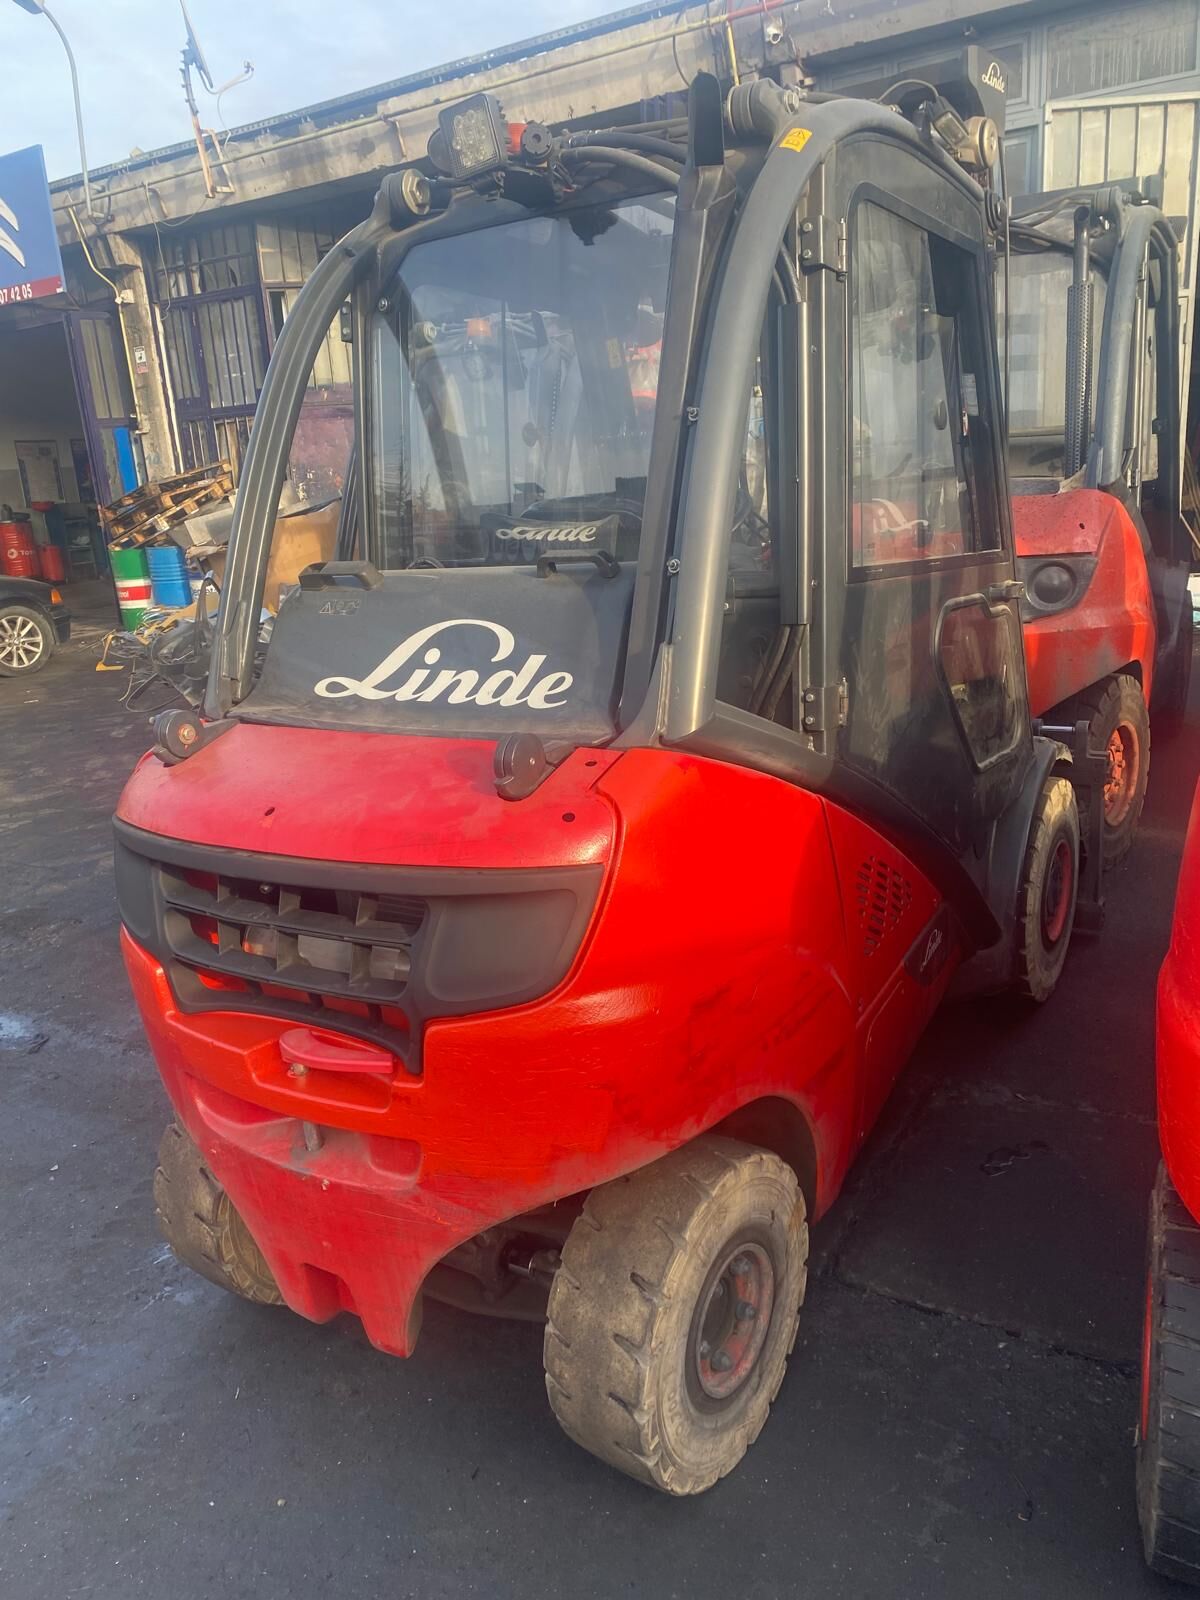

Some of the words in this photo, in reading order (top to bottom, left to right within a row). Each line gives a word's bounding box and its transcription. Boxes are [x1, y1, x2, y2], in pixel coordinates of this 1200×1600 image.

[981, 62, 1005, 93] Linde
[10, 285, 21, 301] 42
[21, 283, 33, 299] 05
[313, 618, 574, 710] Linde
